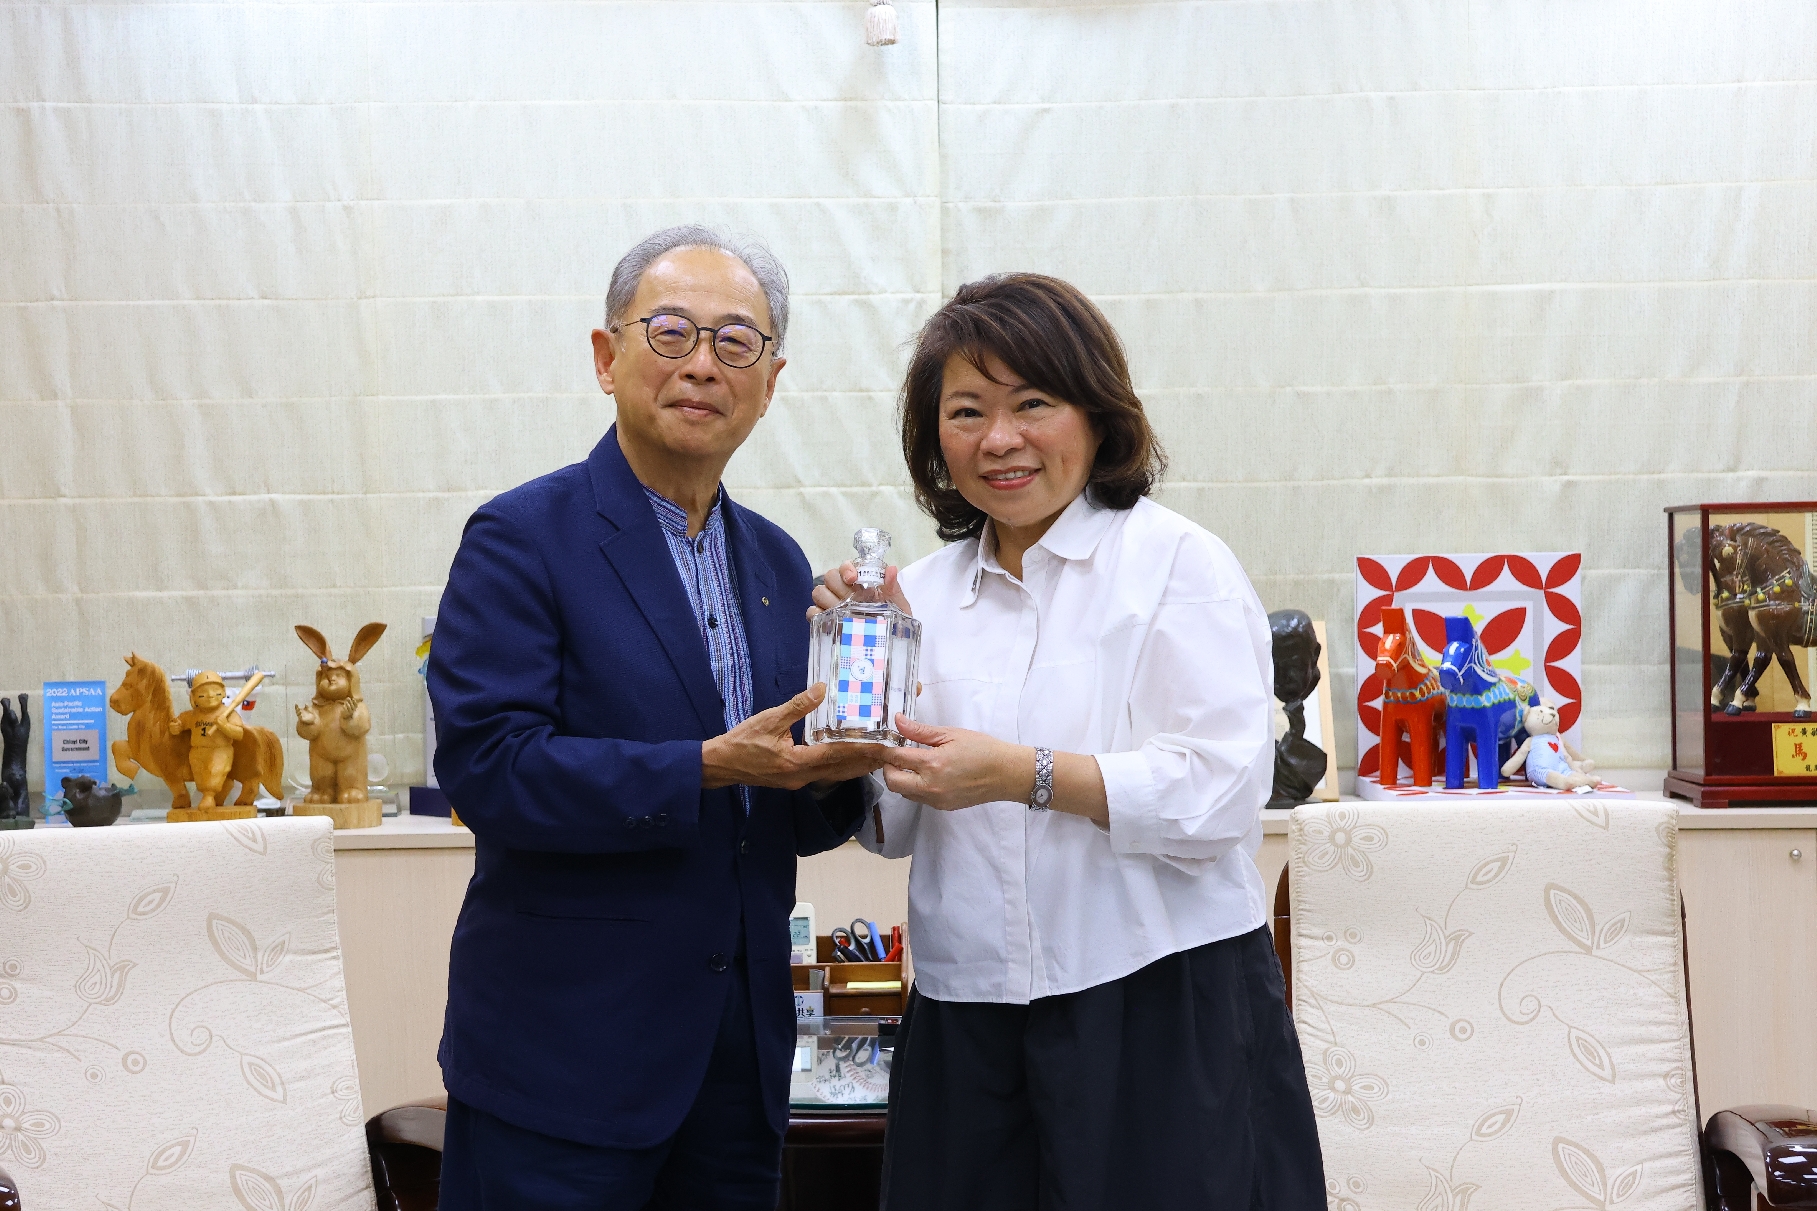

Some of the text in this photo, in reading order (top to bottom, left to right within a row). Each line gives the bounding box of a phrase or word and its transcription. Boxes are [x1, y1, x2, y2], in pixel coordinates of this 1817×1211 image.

[46, 687, 102, 696] 2022 APSAA
[201, 726, 206, 737] 1
[1792, 742, 1807, 761] 馬
[797, 1006, 815, 1017] 共享
